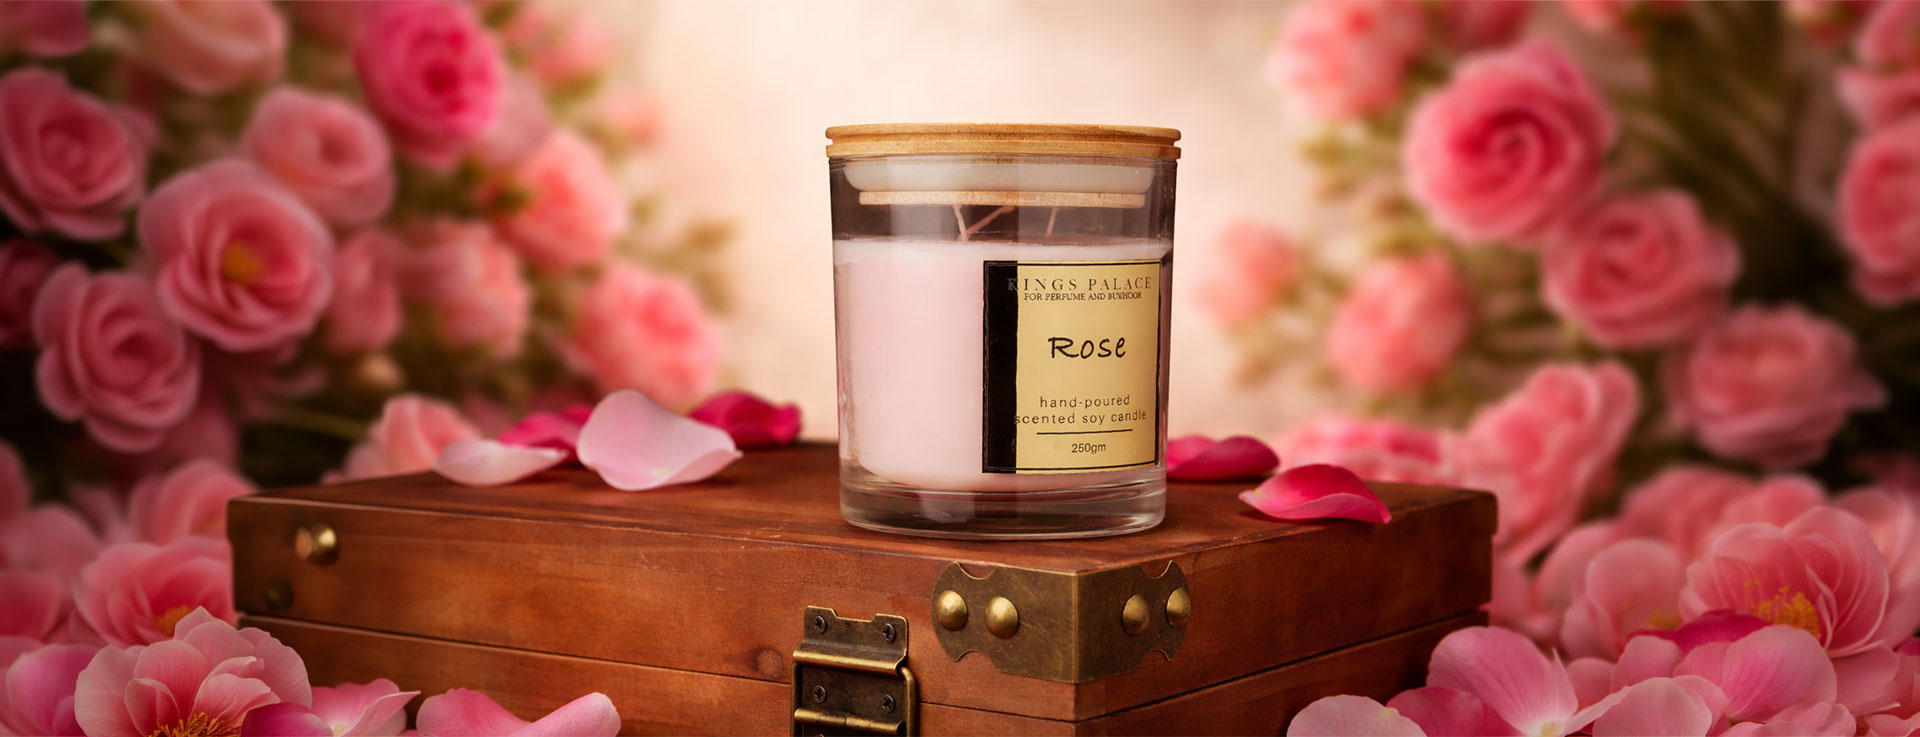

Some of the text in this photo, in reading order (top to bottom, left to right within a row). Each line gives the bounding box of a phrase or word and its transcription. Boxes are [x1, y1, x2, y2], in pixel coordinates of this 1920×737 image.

[1007, 277, 1151, 291] KINGS PALACE
[1024, 293, 1043, 301] FOR
[1045, 292, 1085, 301] PERFUME
[1088, 292, 1106, 300] AND
[1047, 336, 1126, 359] Rose
[1040, 394, 1130, 409] hand-poured
[1014, 409, 1147, 425] scented soy candle
[1071, 443, 1106, 454] 250gm
